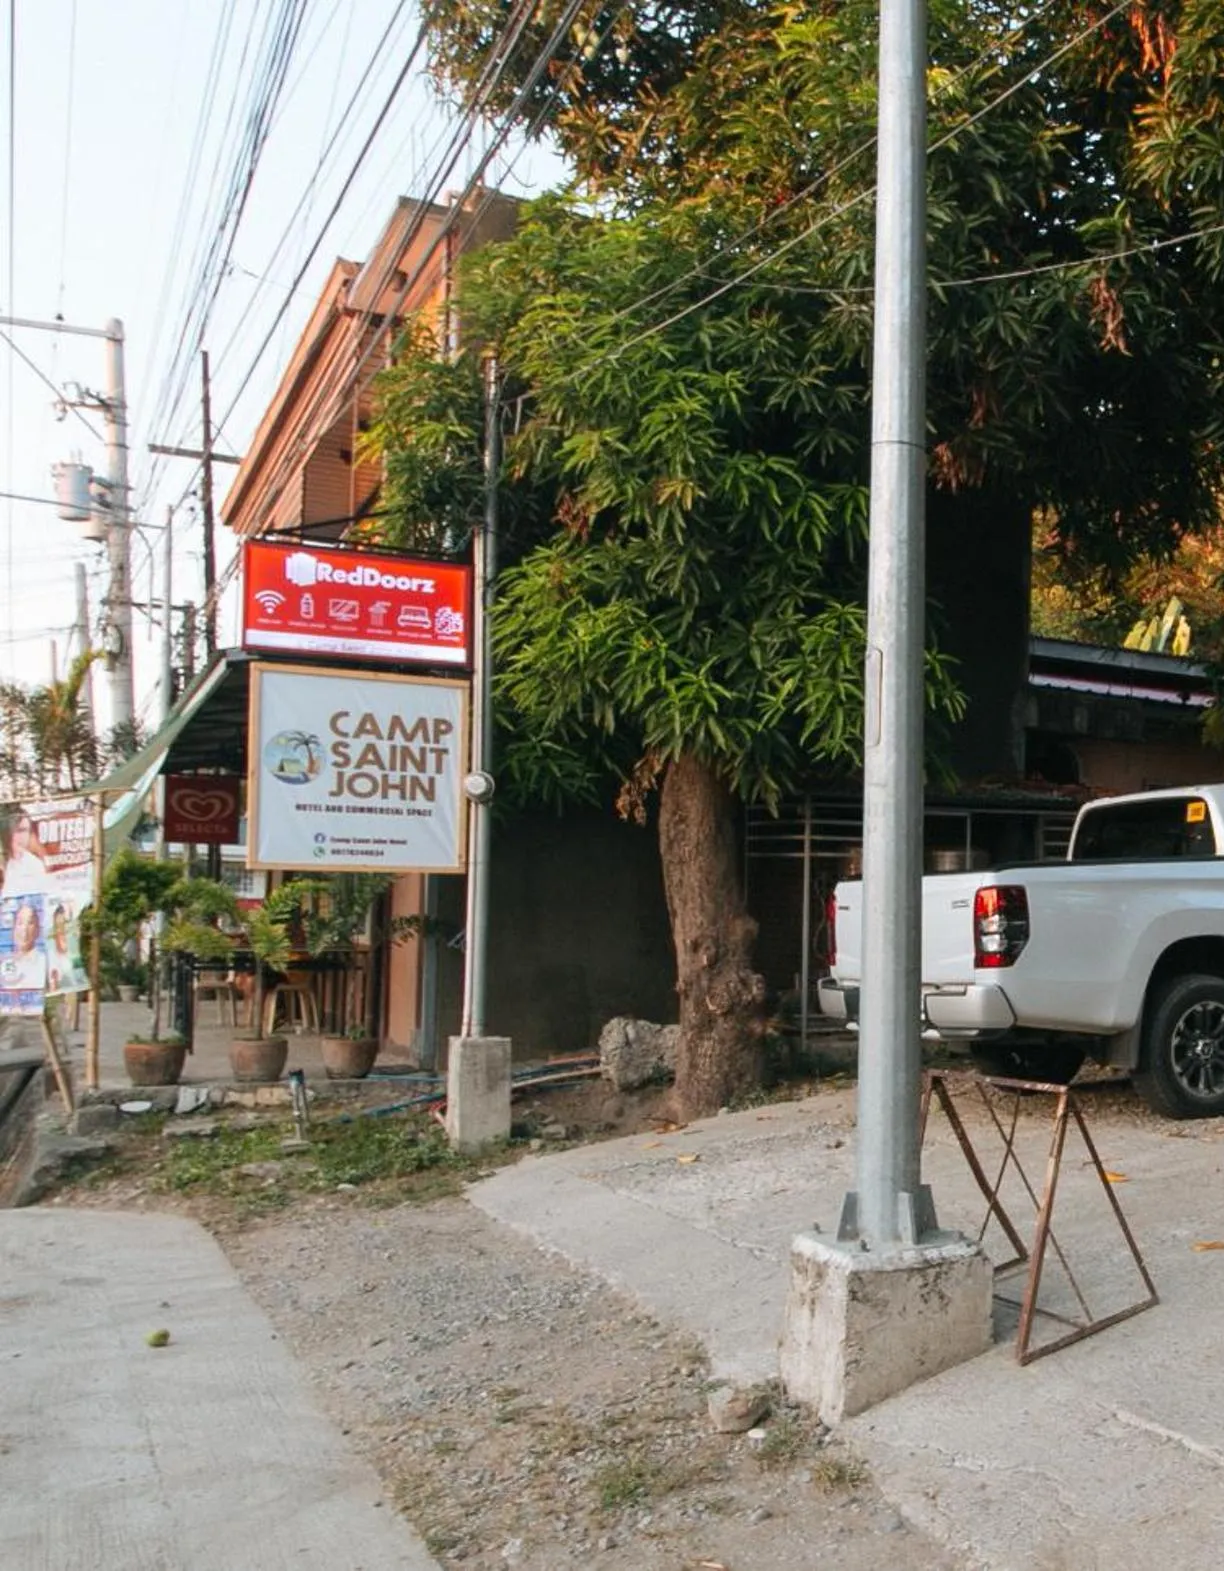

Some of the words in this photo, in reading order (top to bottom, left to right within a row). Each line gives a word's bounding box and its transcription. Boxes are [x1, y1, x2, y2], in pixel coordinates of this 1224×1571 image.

[315, 563, 436, 593] RedDoorz
[328, 710, 454, 744] CAMP
[330, 741, 450, 775] SAINT
[328, 771, 437, 802] JOHN
[296, 803, 322, 812] HOTEL
[325, 805, 343, 813] AND
[346, 806, 404, 816] COMMERCIAL
[407, 808, 432, 817] SPACE
